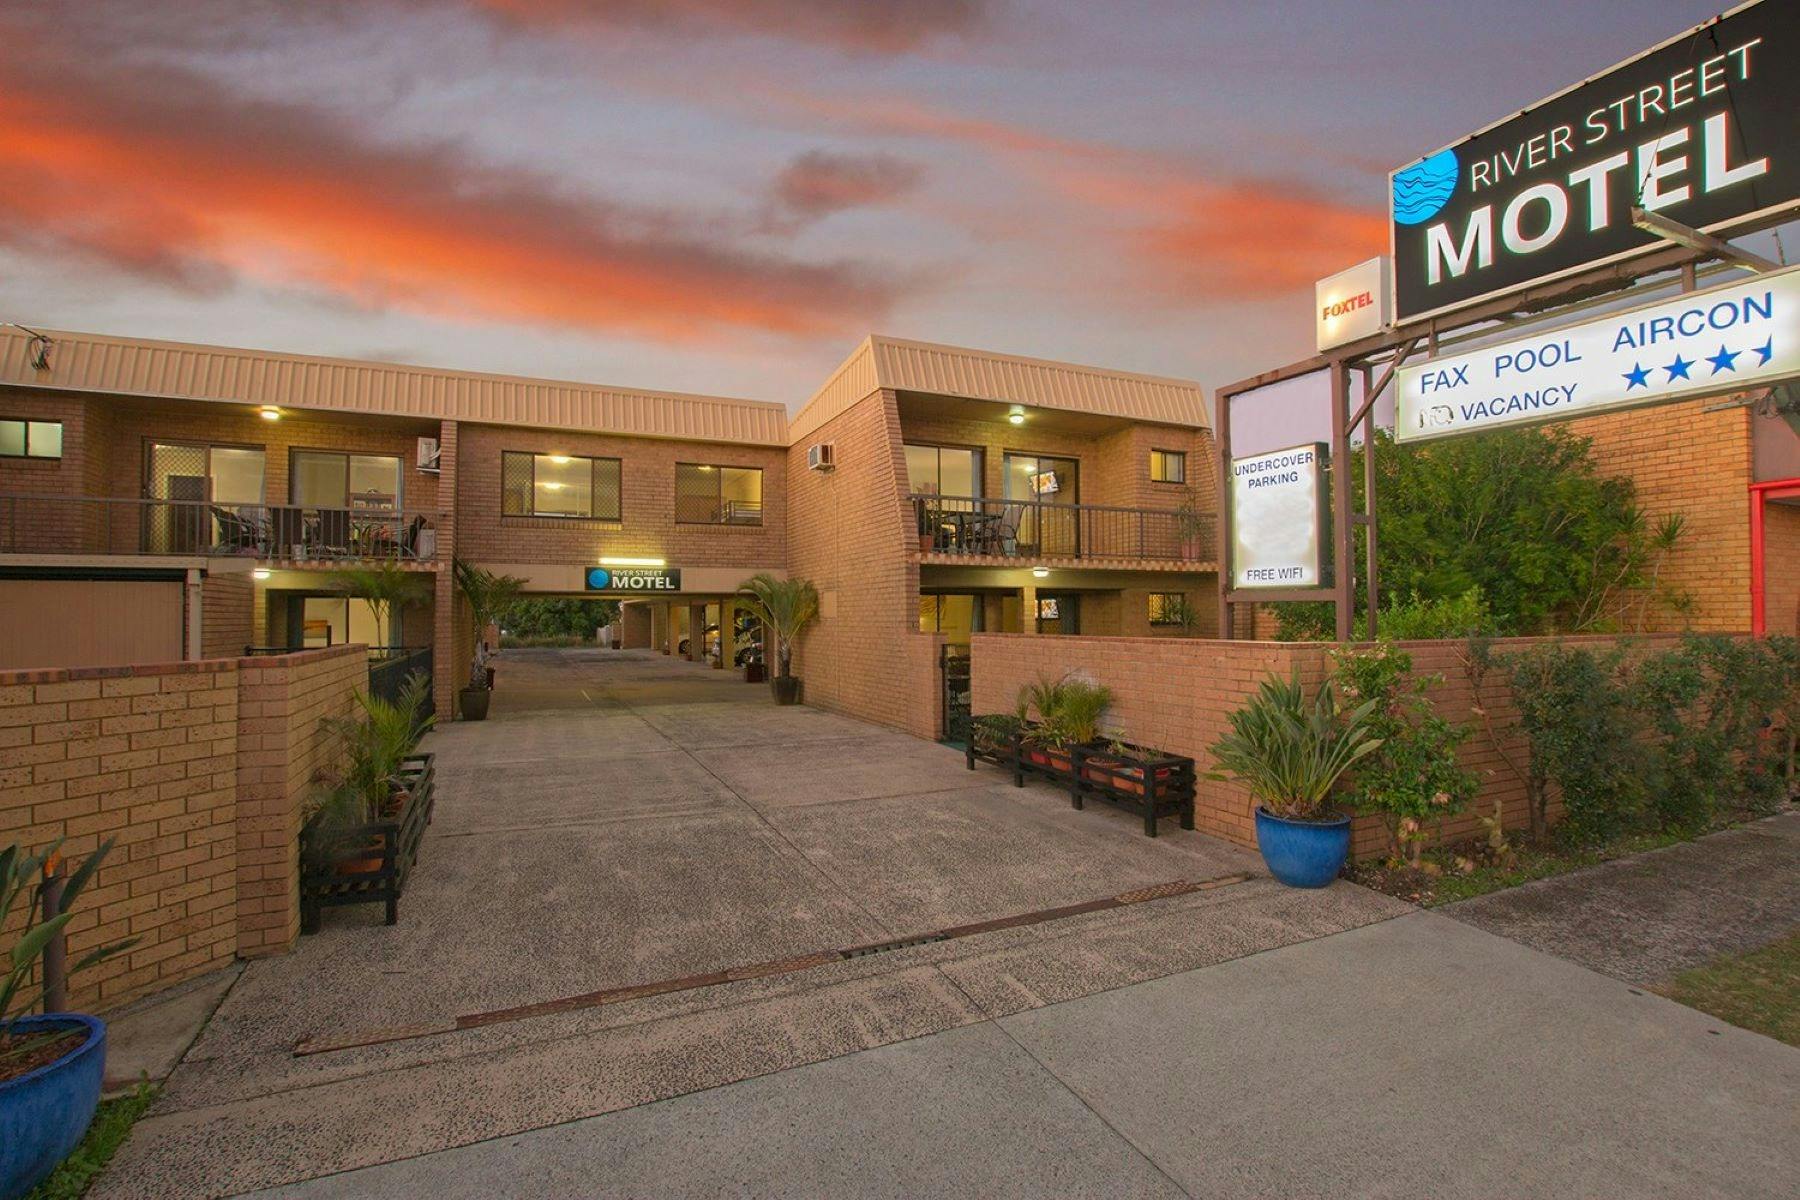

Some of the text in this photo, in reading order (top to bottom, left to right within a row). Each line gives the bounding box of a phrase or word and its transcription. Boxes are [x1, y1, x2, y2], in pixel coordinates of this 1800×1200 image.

[1471, 37, 1762, 192] RIVER STREET
[1426, 111, 1770, 286] MOTEL
[1322, 291, 1373, 321] FOXTEL
[1420, 291, 1773, 394] FAX POOL AIRCON
[1460, 383, 1578, 421] VACANCY
[1234, 452, 1314, 476] UNDERCOVER
[1248, 471, 1298, 489] PARKING
[611, 569, 663, 577] RIVER STREET
[611, 576, 675, 589] MOTEL
[1247, 567, 1303, 581] FREE WIFI
